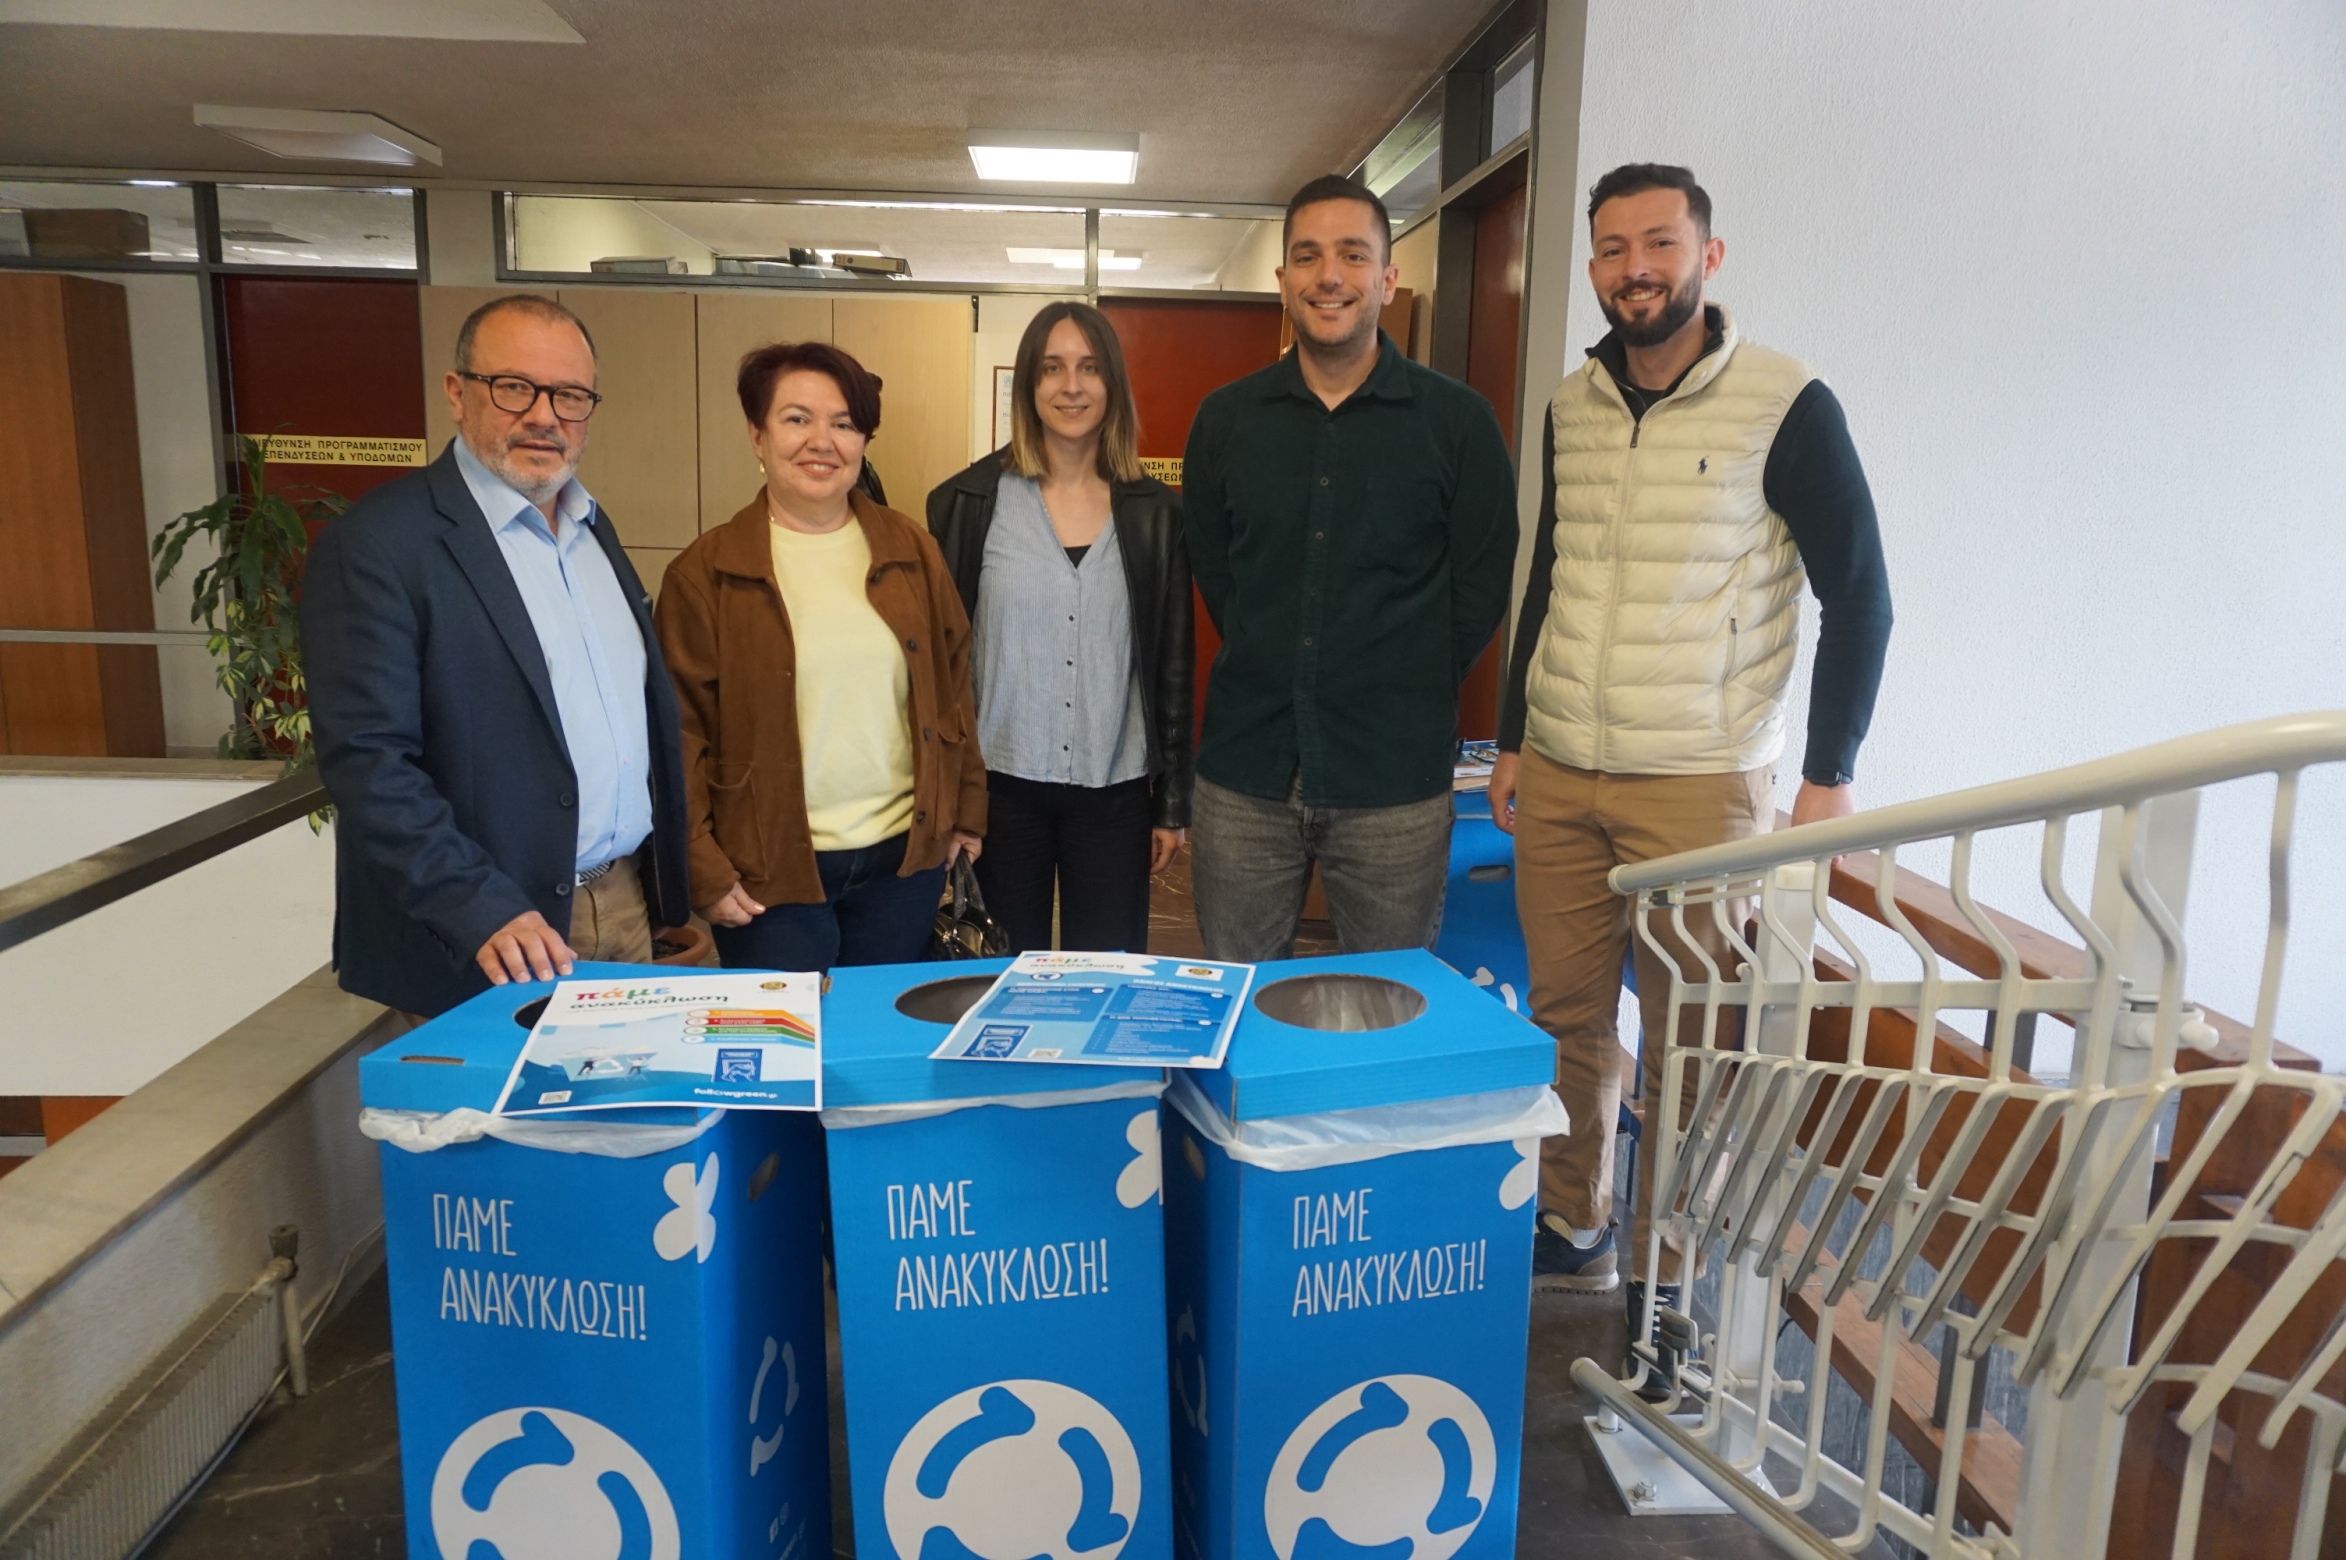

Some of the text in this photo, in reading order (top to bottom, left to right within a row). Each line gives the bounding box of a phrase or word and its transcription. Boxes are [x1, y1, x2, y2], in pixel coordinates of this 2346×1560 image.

[254, 438, 422, 452] ΙΕΥΘΥΝΣΗ ΠΡΟΓΡΑΜΜΑΤΙΣΜΟΥ
[338, 452, 346, 461] &
[350, 453, 412, 463] ΥΠΟΔΟΜΩΝ
[1142, 461, 1164, 470] ΝΣΗ
[569, 995, 729, 1010] ανακύκλωση
[575, 986, 671, 1001] πάμε
[434, 1194, 516, 1256] ΠΑΜΕ
[887, 1180, 976, 1240] ΠΑΜΕ
[1293, 1188, 1373, 1249] ΠΑΜΕ
[441, 1267, 646, 1339] ΑΝΑΚΥΚΛΩΣΗ!
[895, 1238, 1108, 1311] ΑΝΑΚΥΚΛΩΣΗ!
[1292, 1239, 1486, 1317] ΑΝΑΚΥΚΛΩΣΗ!
